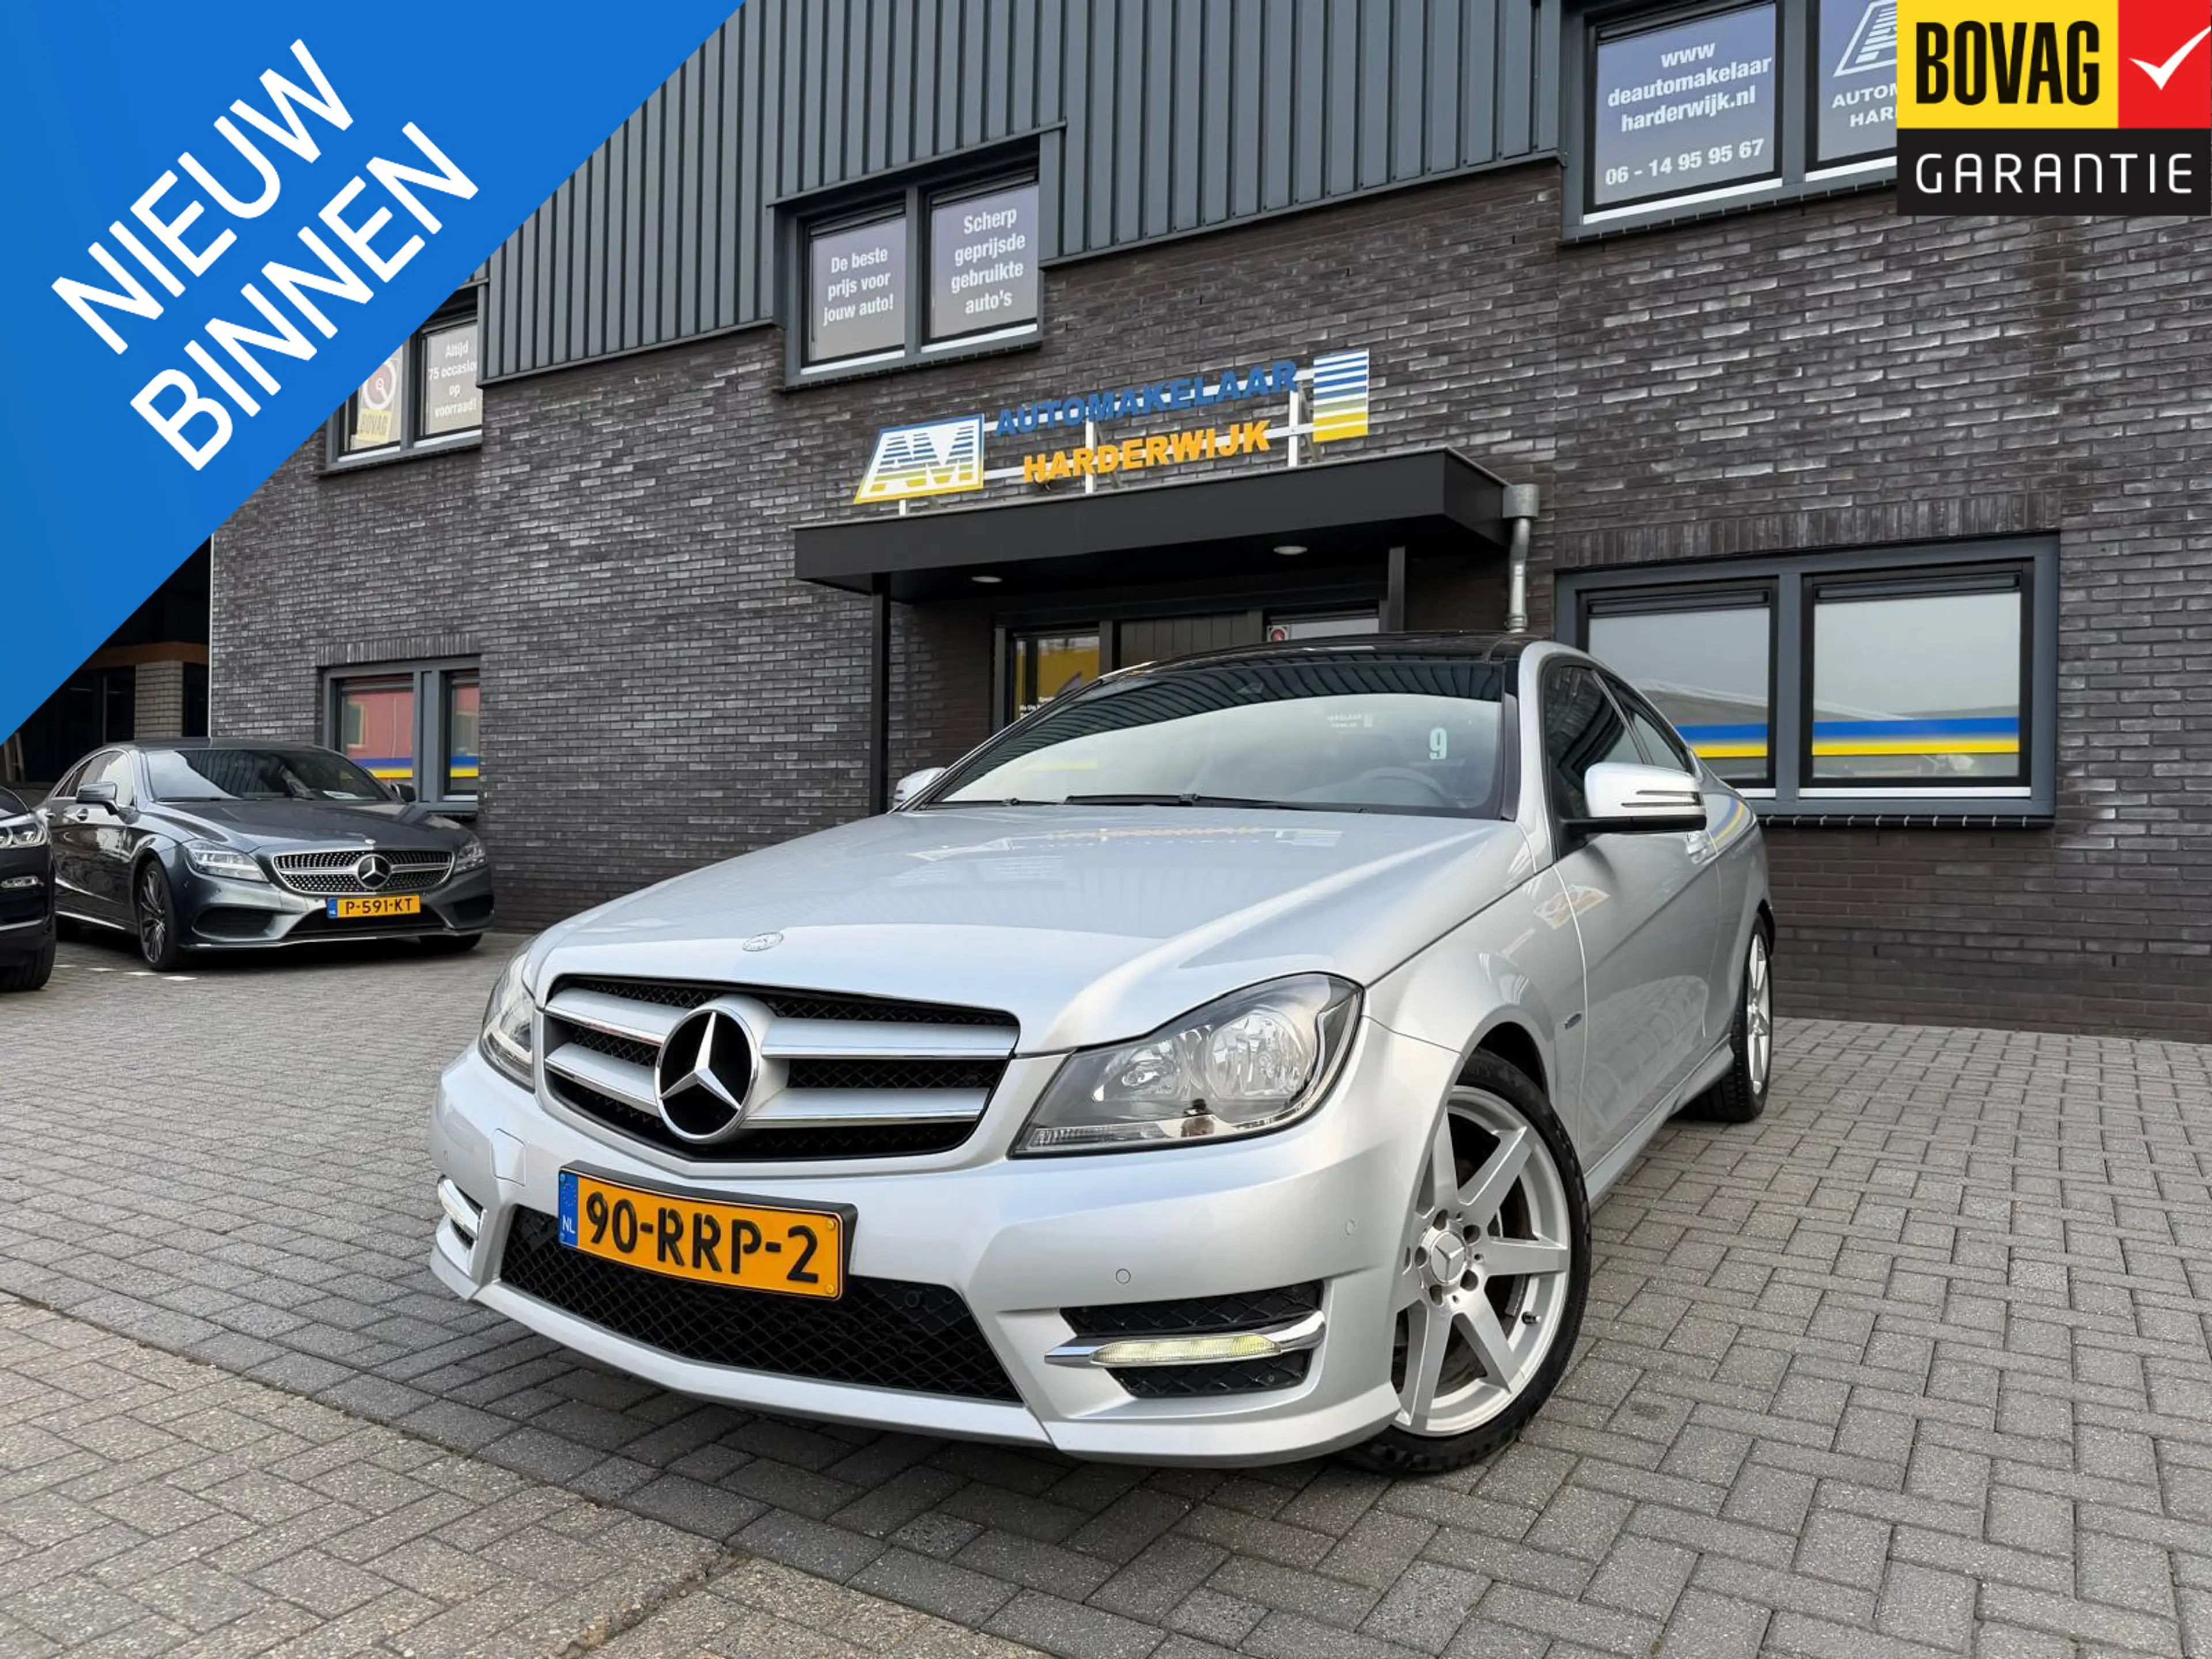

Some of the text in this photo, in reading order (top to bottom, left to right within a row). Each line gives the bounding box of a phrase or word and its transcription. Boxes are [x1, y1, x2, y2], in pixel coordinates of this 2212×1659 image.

[1661, 43, 1715, 68] www
[1608, 57, 1772, 107] deautomakelaar
[1621, 86, 1756, 132] harderwijk.nl
[1850, 105, 1897, 127] HAR
[1605, 166, 1629, 185] 06
[1649, 159, 1672, 177] 14
[1678, 151, 1702, 169] 95
[1709, 146, 1733, 165] 95
[1739, 139, 1764, 158] 67
[964, 209, 1017, 234] Scherp
[831, 248, 888, 273] De beste
[955, 233, 1026, 266] geprijsde
[828, 272, 891, 301] prijs voor
[951, 262, 1024, 294] gebruikte
[823, 294, 894, 327] jouw auto!
[965, 291, 1013, 315] auto's
[995, 360, 1298, 437] AUTOMAKELAAR
[1022, 420, 1271, 483] HARDERWIJK
[346, 899, 412, 914] P-591-KT
[562, 1191, 819, 1283] NL 90-RRP-2
